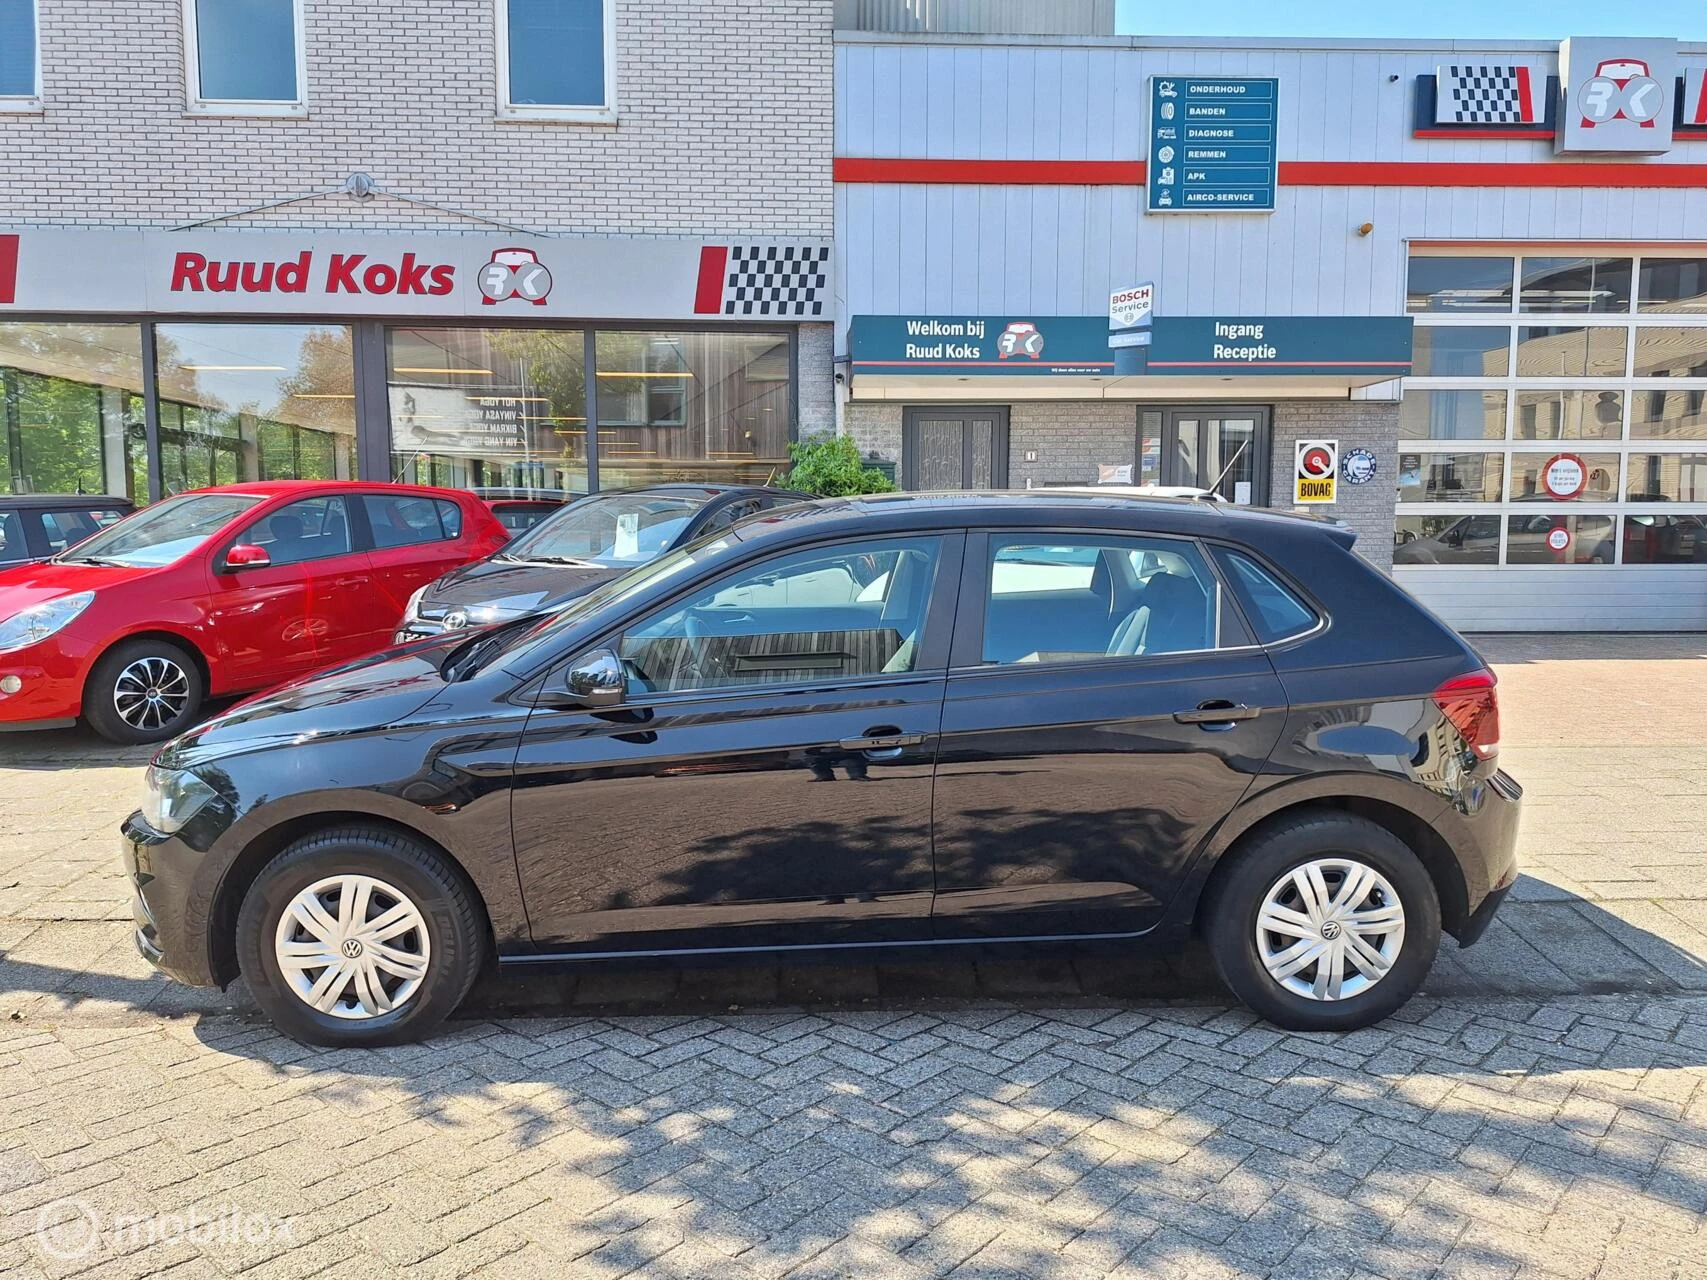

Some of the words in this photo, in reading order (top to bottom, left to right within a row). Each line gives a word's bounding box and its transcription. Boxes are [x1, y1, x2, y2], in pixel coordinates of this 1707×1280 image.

[1190, 85, 1246, 93] ONDERHOUD
[1188, 129, 1234, 137] DIAGNOSE
[1187, 172, 1206, 180] APK
[1186, 193, 1254, 201] AIRCO-SERVICE
[170, 251, 312, 293] Ruud
[325, 253, 455, 295] Koks
[1112, 288, 1149, 304] BOSCH
[1112, 301, 1149, 314] Service
[907, 320, 963, 336] Welkom
[967, 320, 985, 339] bij
[1215, 322, 1264, 339] Ingang
[905, 343, 943, 359] Ruud
[946, 344, 980, 359] Koks
[1213, 344, 1276, 361] Receptie
[1300, 482, 1331, 497] BOVAG
